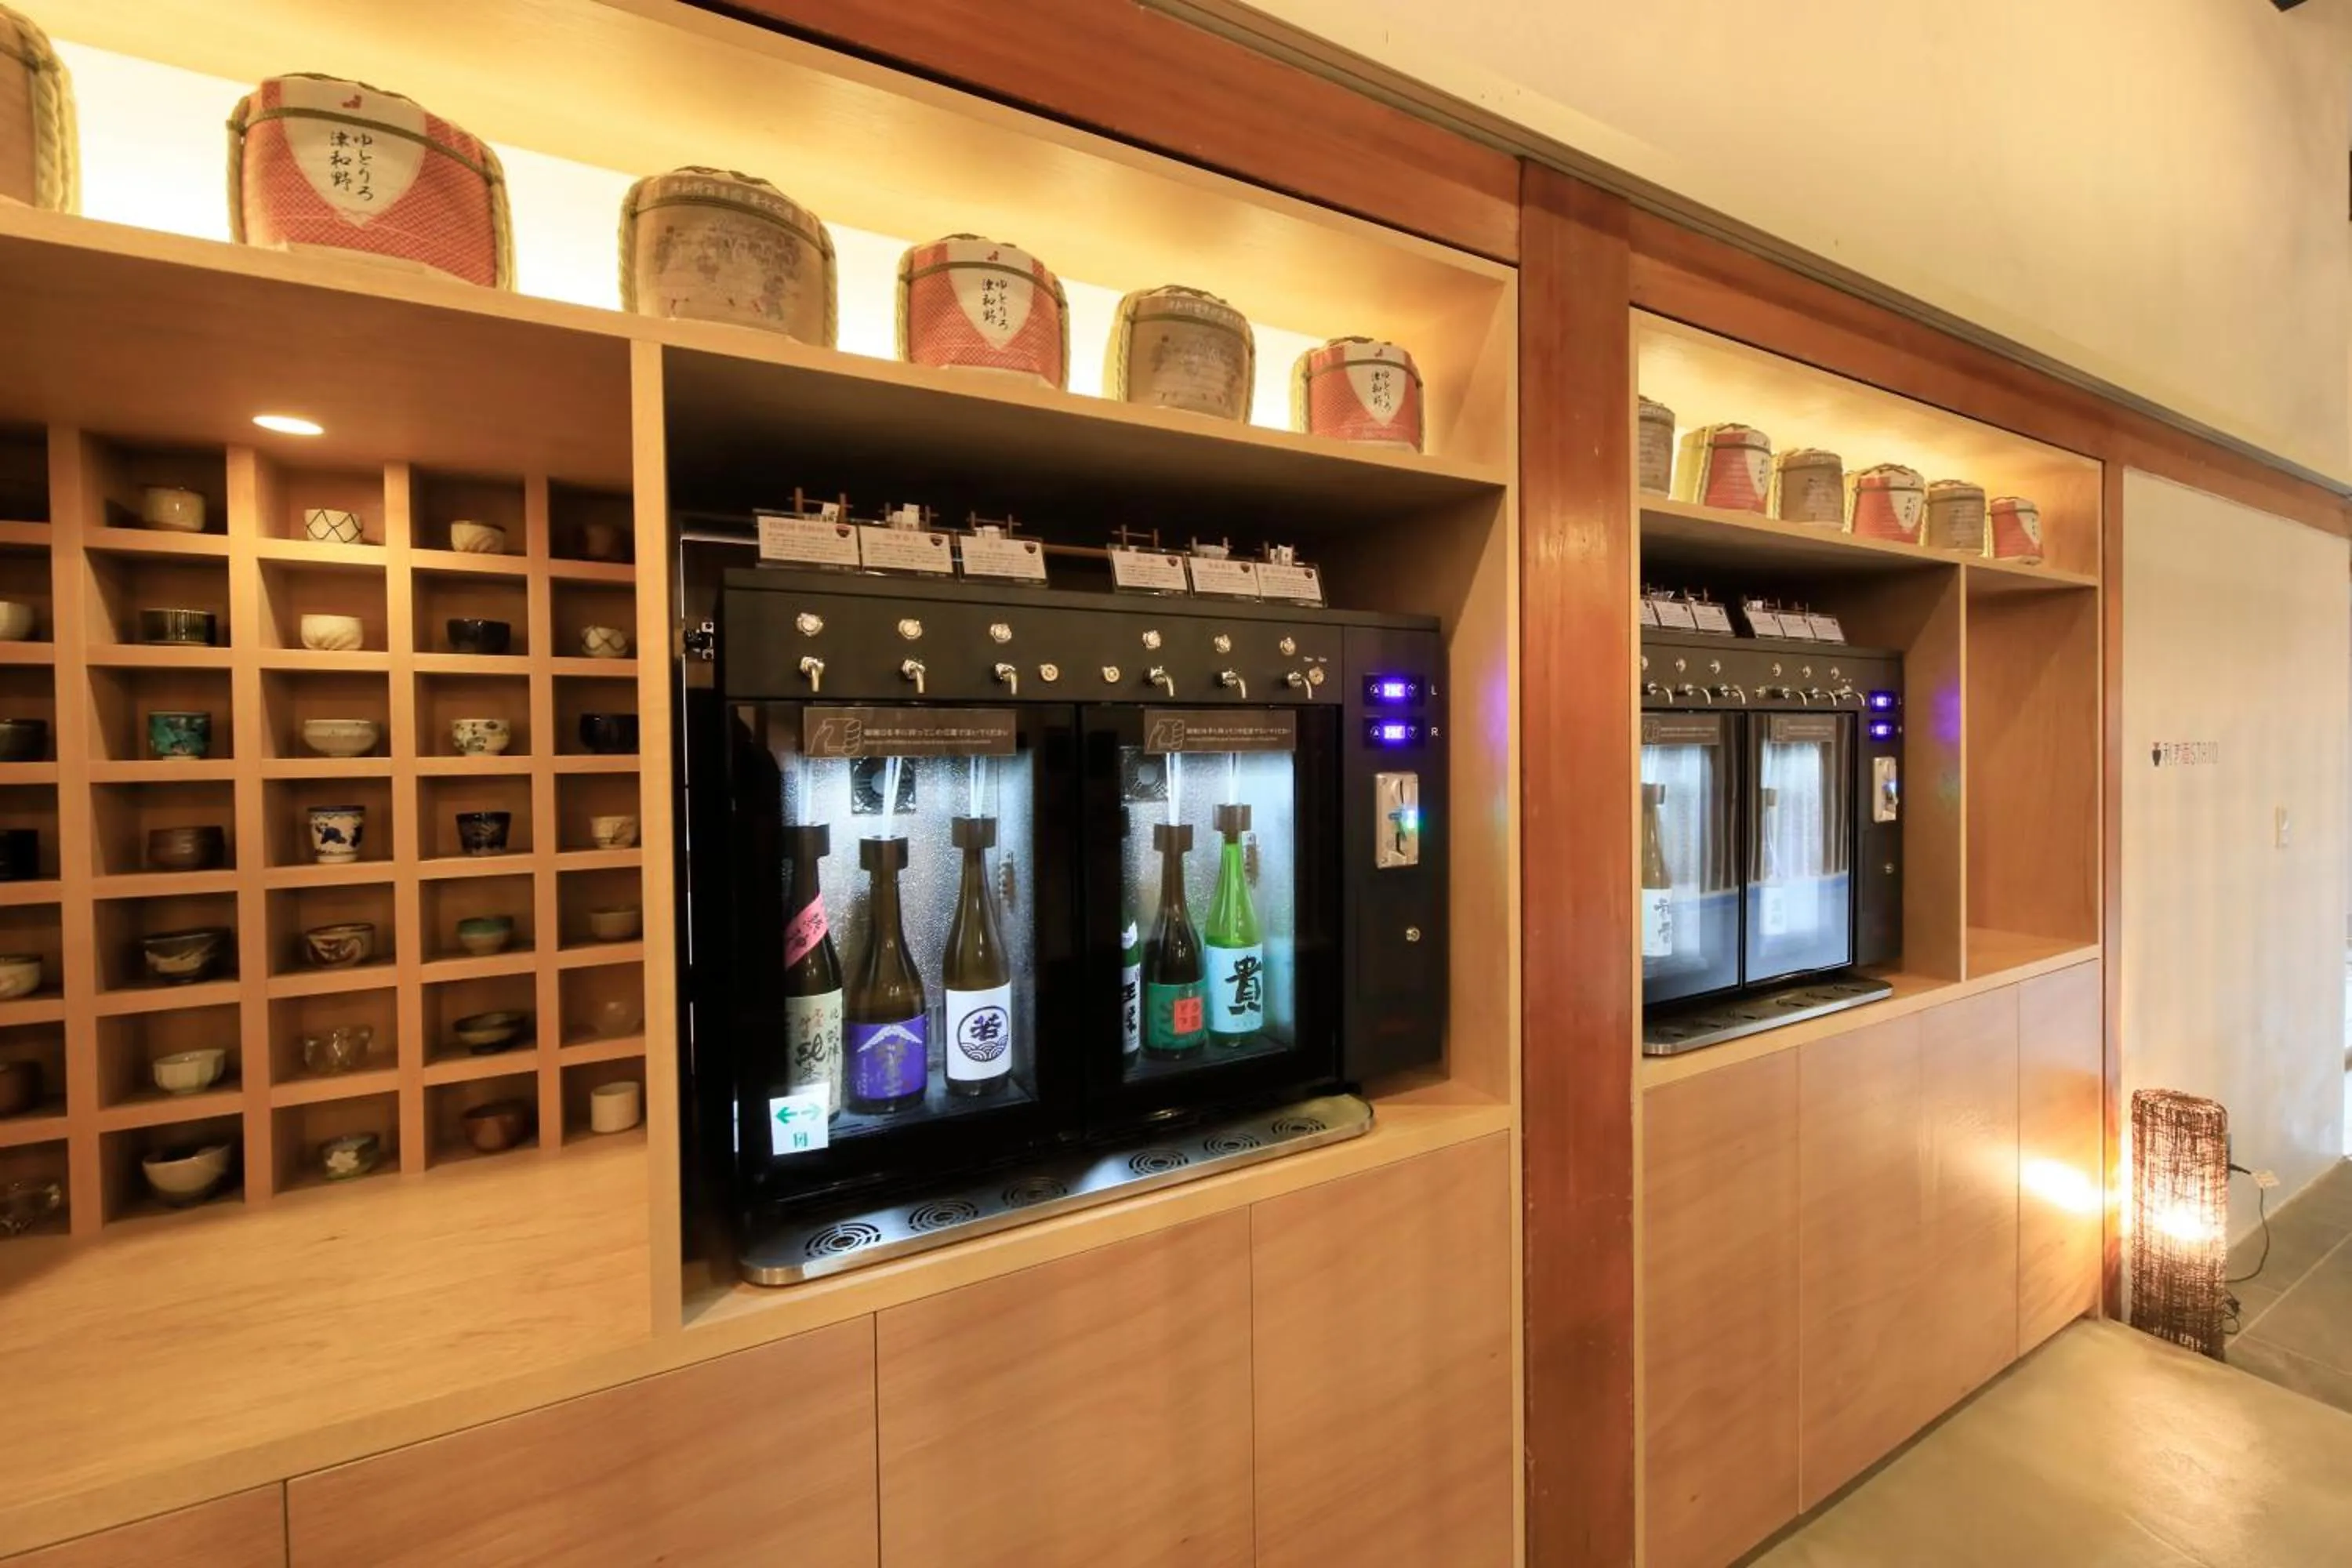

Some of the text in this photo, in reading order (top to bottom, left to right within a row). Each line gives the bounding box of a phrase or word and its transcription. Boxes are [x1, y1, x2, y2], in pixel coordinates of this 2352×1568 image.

[330, 129, 352, 191] 津和野
[353, 132, 374, 201] ゆとりろ
[982, 278, 996, 323] 津和野
[995, 279, 1008, 330] ゆとりろ
[1430, 683, 1438, 695] L
[1431, 727, 1439, 737] R
[1224, 954, 1262, 1015] 貴
[969, 1012, 1002, 1042] 若
